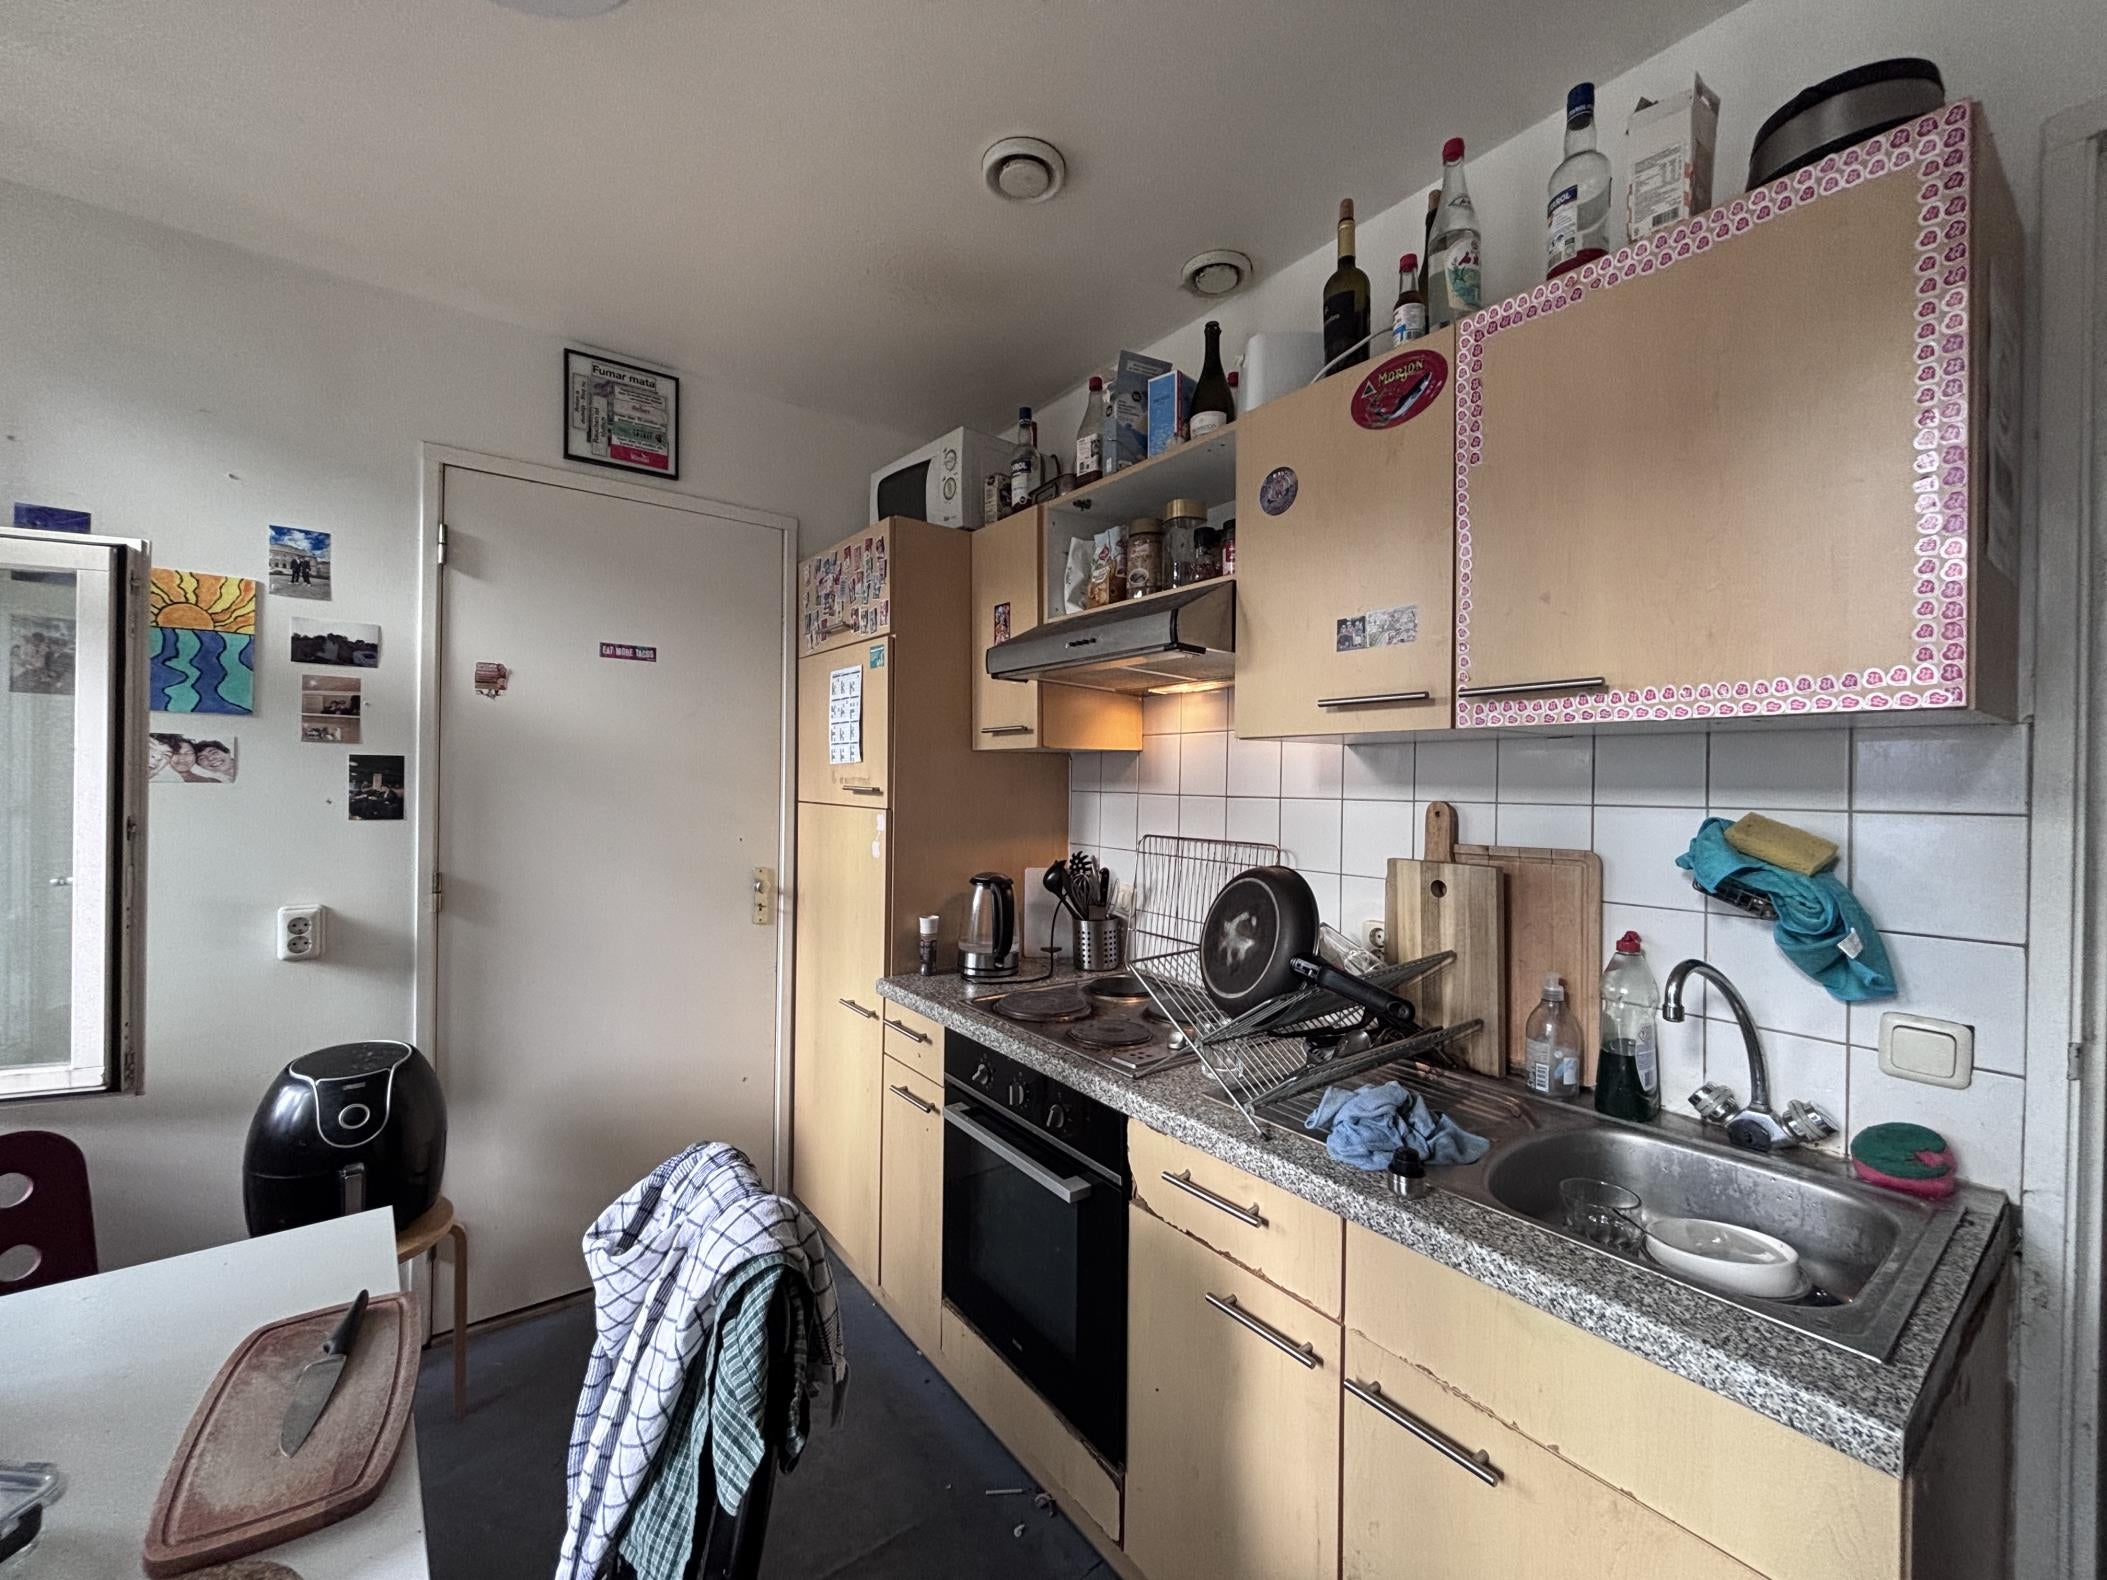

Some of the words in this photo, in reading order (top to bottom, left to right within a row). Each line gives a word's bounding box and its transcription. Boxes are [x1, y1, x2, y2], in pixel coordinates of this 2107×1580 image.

[592, 364, 627, 381] Fumar
[629, 375, 656, 389] mata
[602, 645, 614, 655] EAT
[635, 648, 655, 659] TACOS
